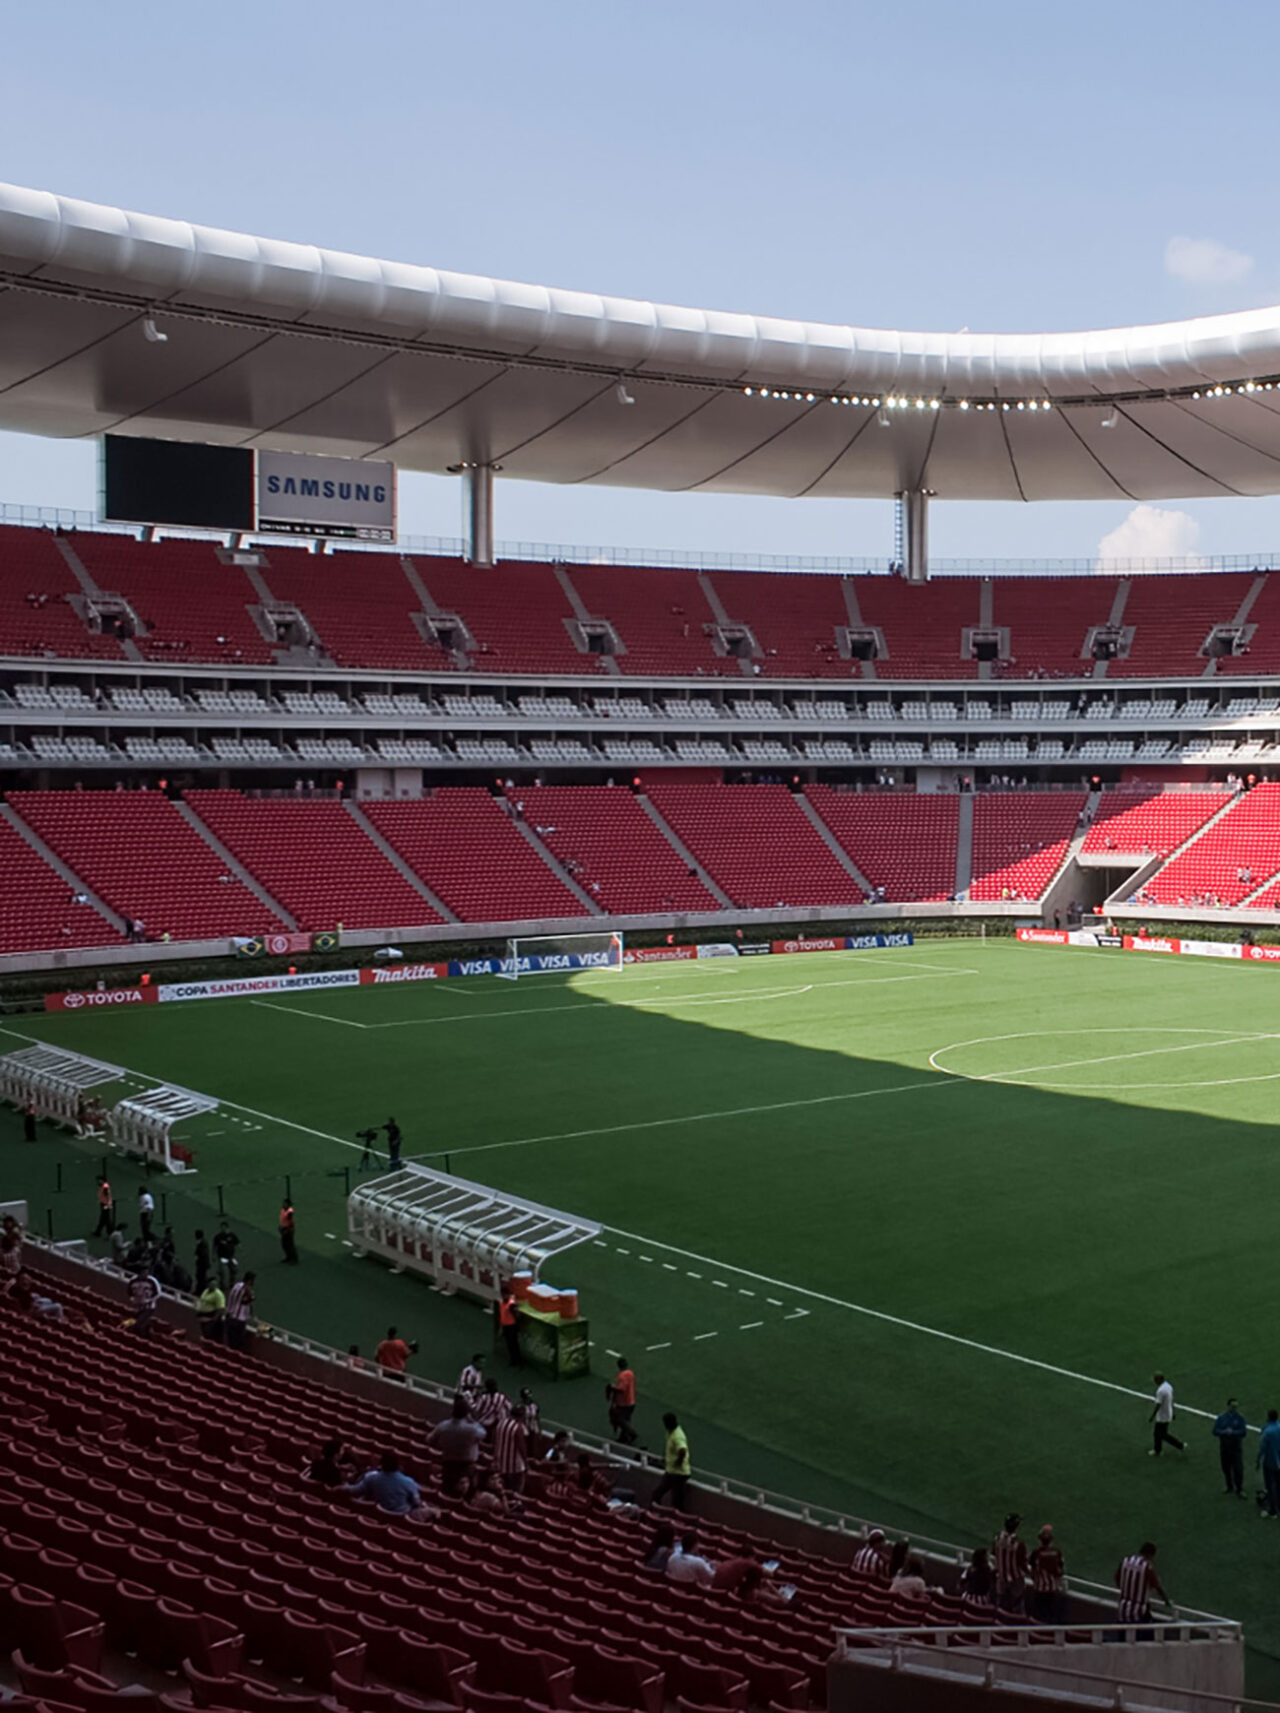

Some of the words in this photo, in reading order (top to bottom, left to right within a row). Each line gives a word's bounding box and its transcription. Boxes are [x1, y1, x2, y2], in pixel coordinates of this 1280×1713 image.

[267, 475, 386, 503] SAMSUNG
[800, 940, 835, 950] TOYOTA
[852, 936, 878, 949] VISA
[883, 934, 909, 947] VISA
[636, 948, 692, 962] Santander
[460, 961, 493, 975] VISA
[538, 955, 571, 968] VISA
[577, 952, 610, 966] VISA
[176, 986, 208, 997] COPA
[210, 981, 278, 994] SANTANDER
[279, 973, 358, 988] LIBERTADORES
[87, 990, 142, 1005] TOYOTA
